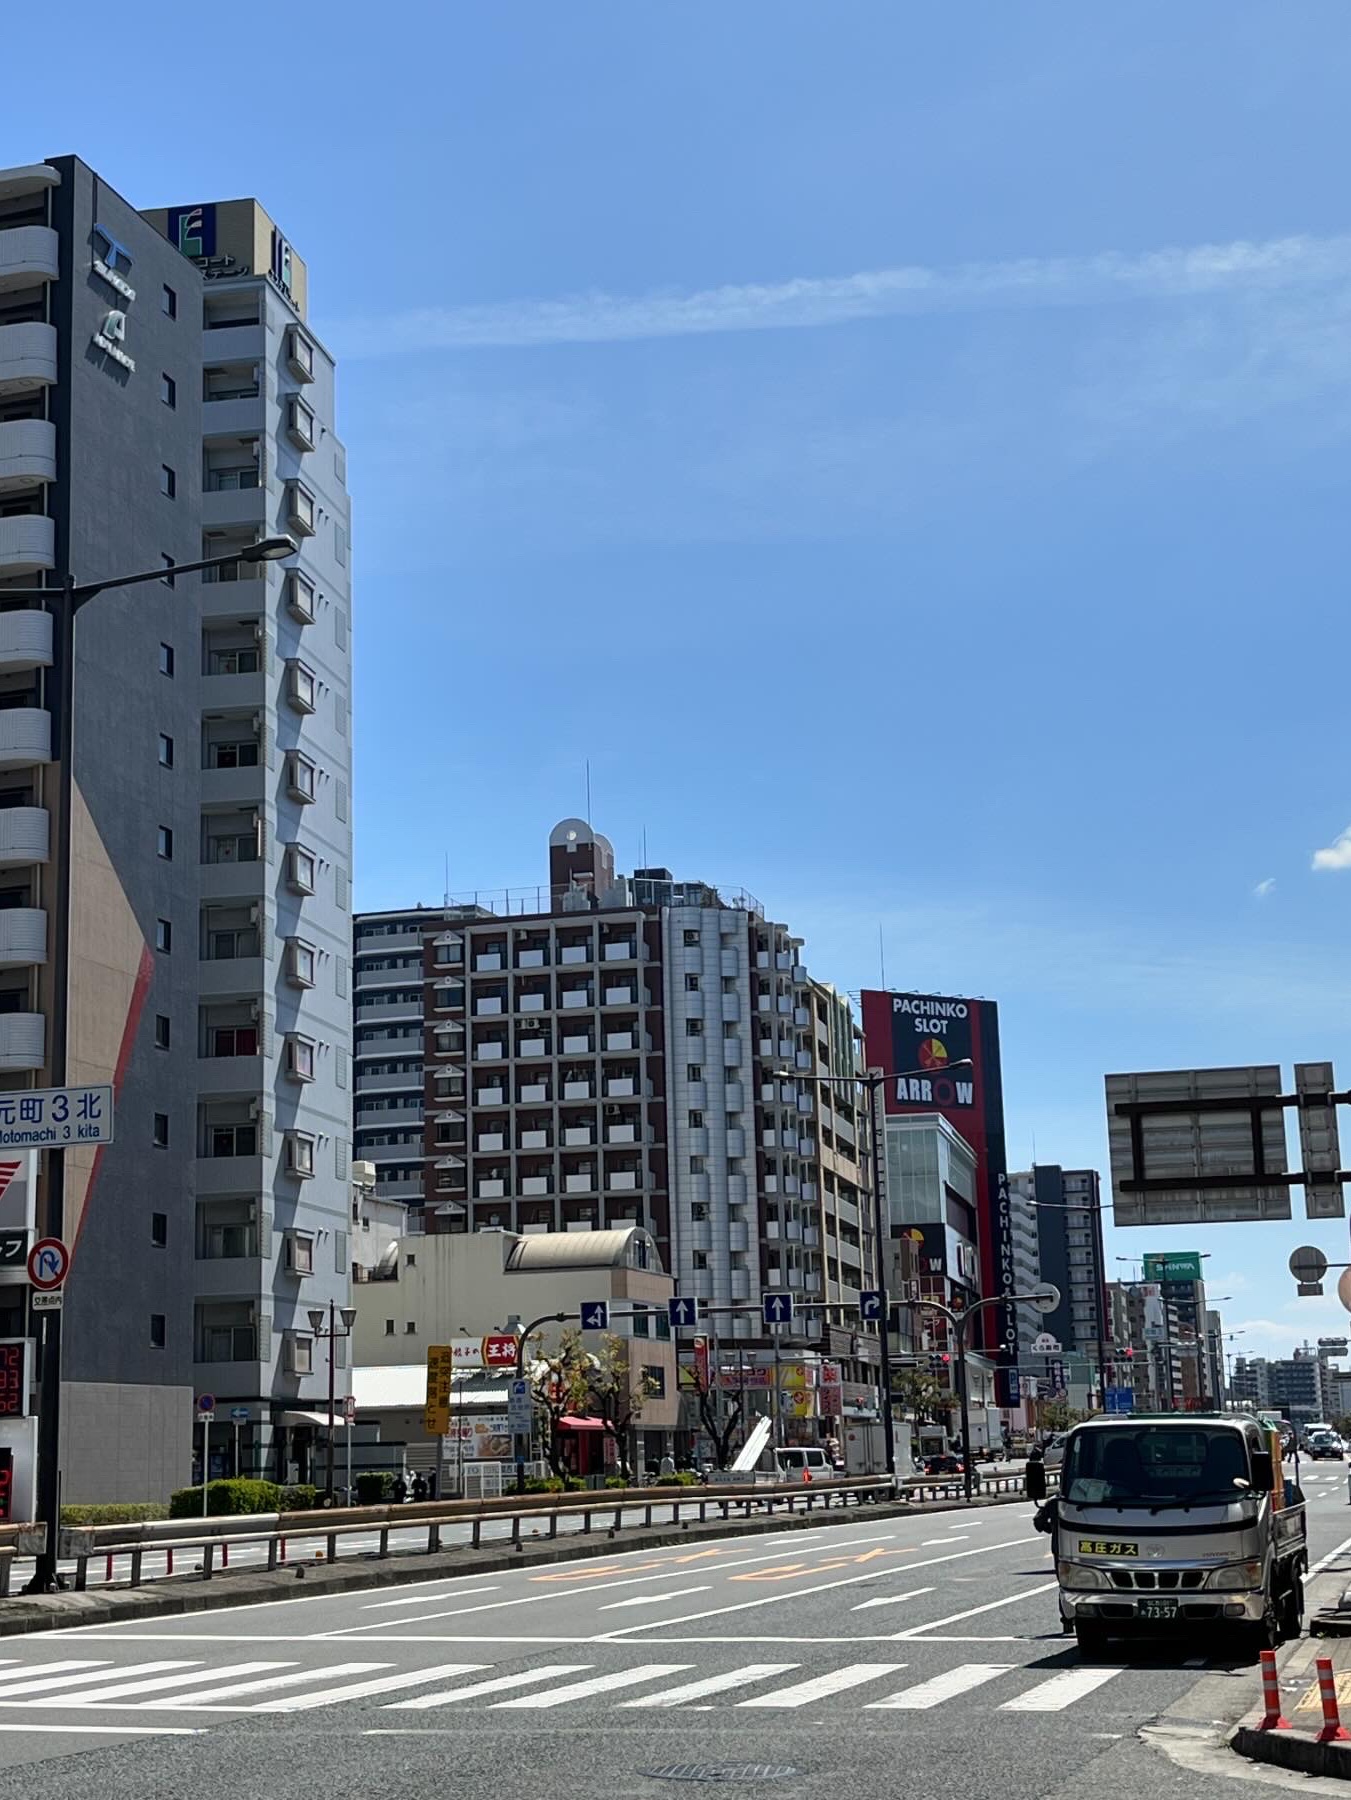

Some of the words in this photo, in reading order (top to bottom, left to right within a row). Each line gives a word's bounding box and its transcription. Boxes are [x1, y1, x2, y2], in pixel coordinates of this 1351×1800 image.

[893, 998, 968, 1018] PACHINKO
[914, 1018, 948, 1034] SLOT
[896, 1078, 973, 1105] ARROW
[0, 1127, 56, 1143] otomachi
[63, 1125, 70, 1139] 3
[78, 1123, 100, 1138] kita
[0, 1241, 22, 1257] フ
[1079, 1540, 1138, 1556] 高圧ガス
